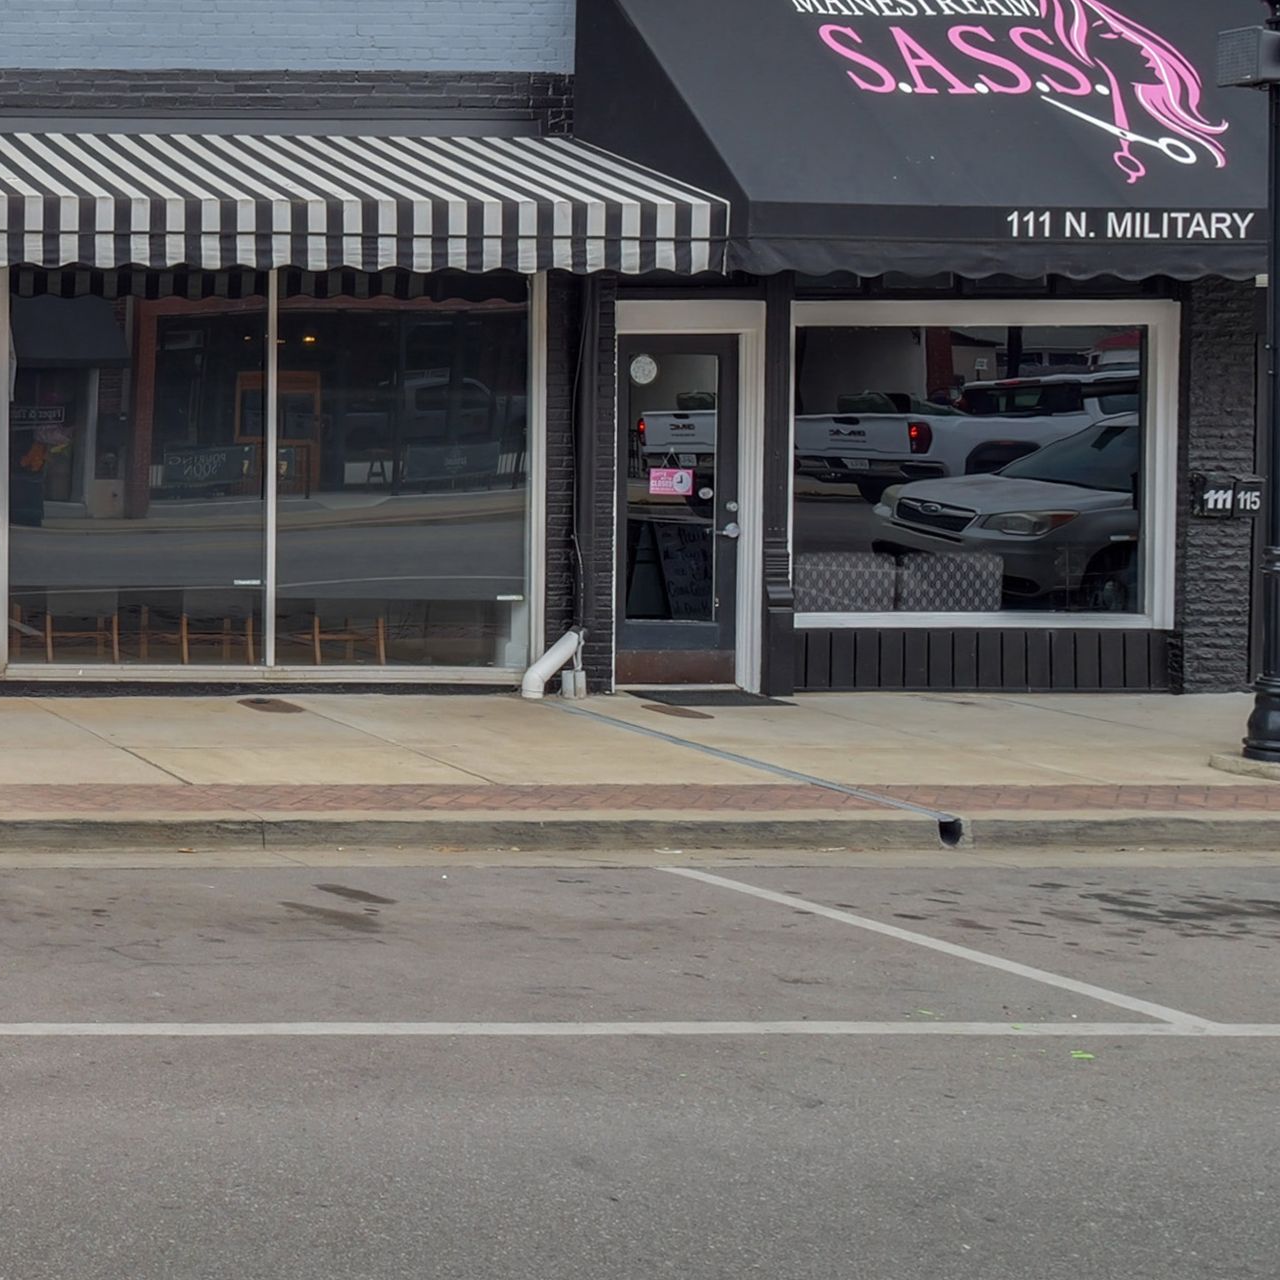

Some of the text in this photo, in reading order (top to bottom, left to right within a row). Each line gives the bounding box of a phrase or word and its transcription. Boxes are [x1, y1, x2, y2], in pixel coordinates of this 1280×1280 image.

[1006, 210, 1255, 239] 111 N. MILITARY
[1203, 489, 1233, 509] 111
[1237, 490, 1261, 510] 115
